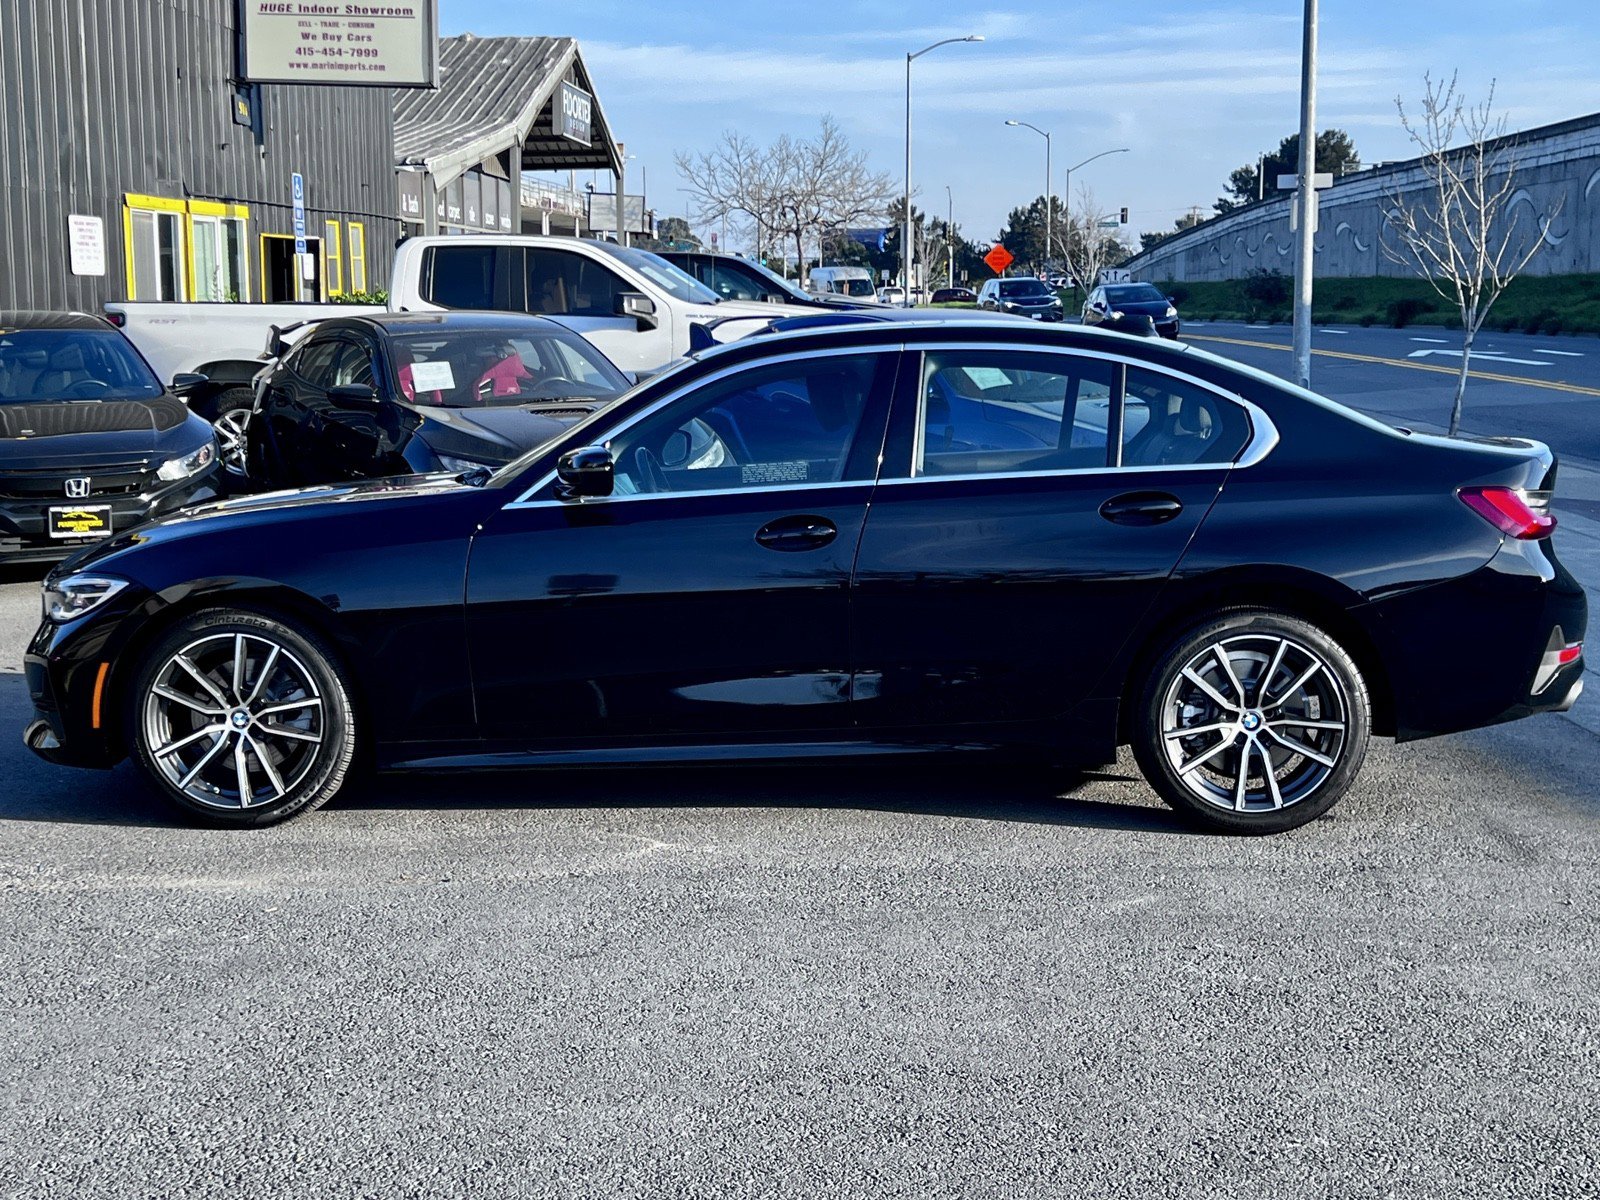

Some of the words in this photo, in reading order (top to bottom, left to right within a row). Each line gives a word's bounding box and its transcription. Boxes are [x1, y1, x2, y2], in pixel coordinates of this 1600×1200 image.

[260, 3, 293, 13] HUGE
[298, 3, 339, 14] Indoor
[345, 4, 413, 16] Showroom
[301, 31, 317, 41] We
[322, 32, 342, 42] Buy
[347, 33, 372, 42] Cars
[295, 46, 378, 58] 415-454-7999
[288, 61, 386, 71] www.marinimports.com
[205, 615, 268, 628] Cinturato
